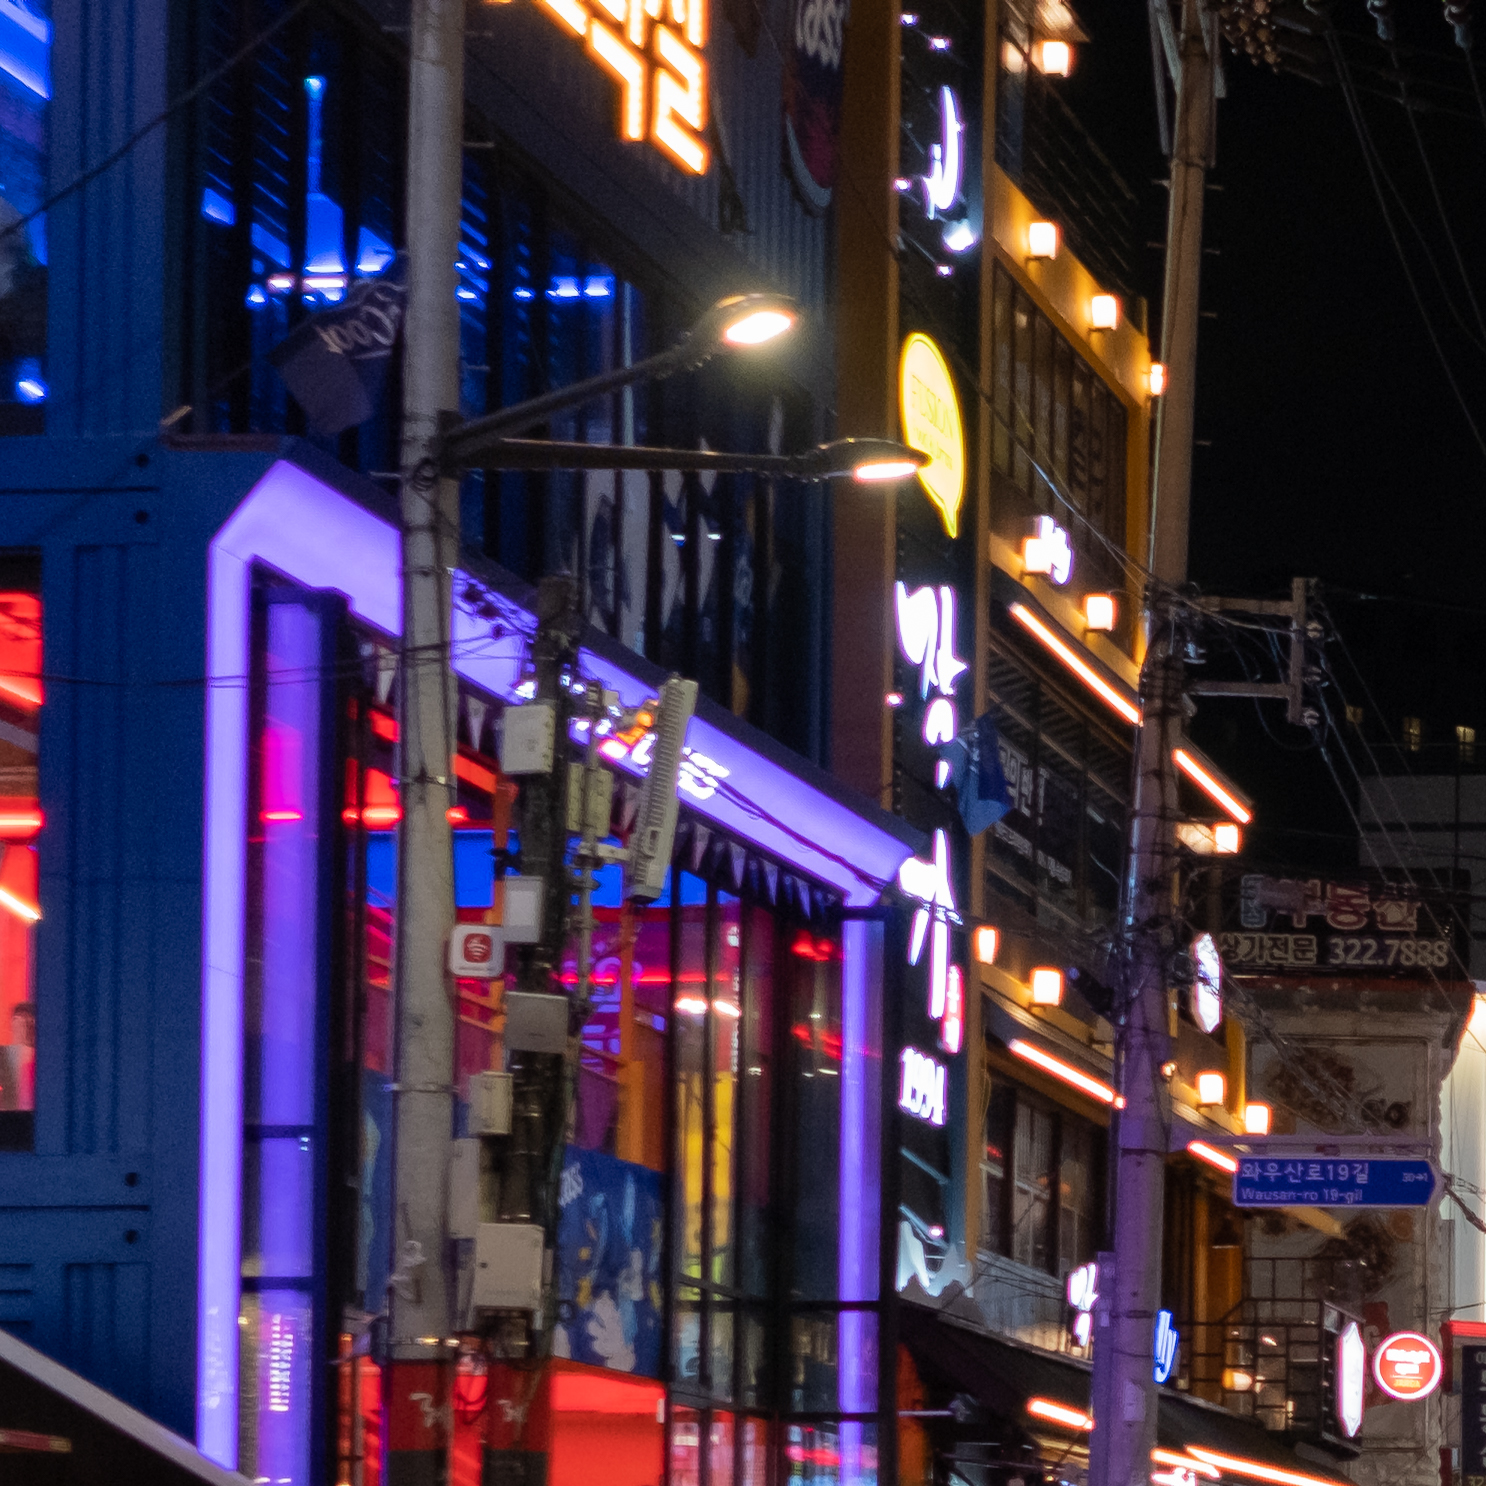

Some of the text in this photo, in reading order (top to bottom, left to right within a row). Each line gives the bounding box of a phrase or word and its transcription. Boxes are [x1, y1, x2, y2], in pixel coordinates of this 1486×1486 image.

[1328, 937, 1449, 968] 322.7888
[1241, 1162, 1370, 1184] 와우산로19길
[1241, 1188, 1319, 1202] Wausan-ro
